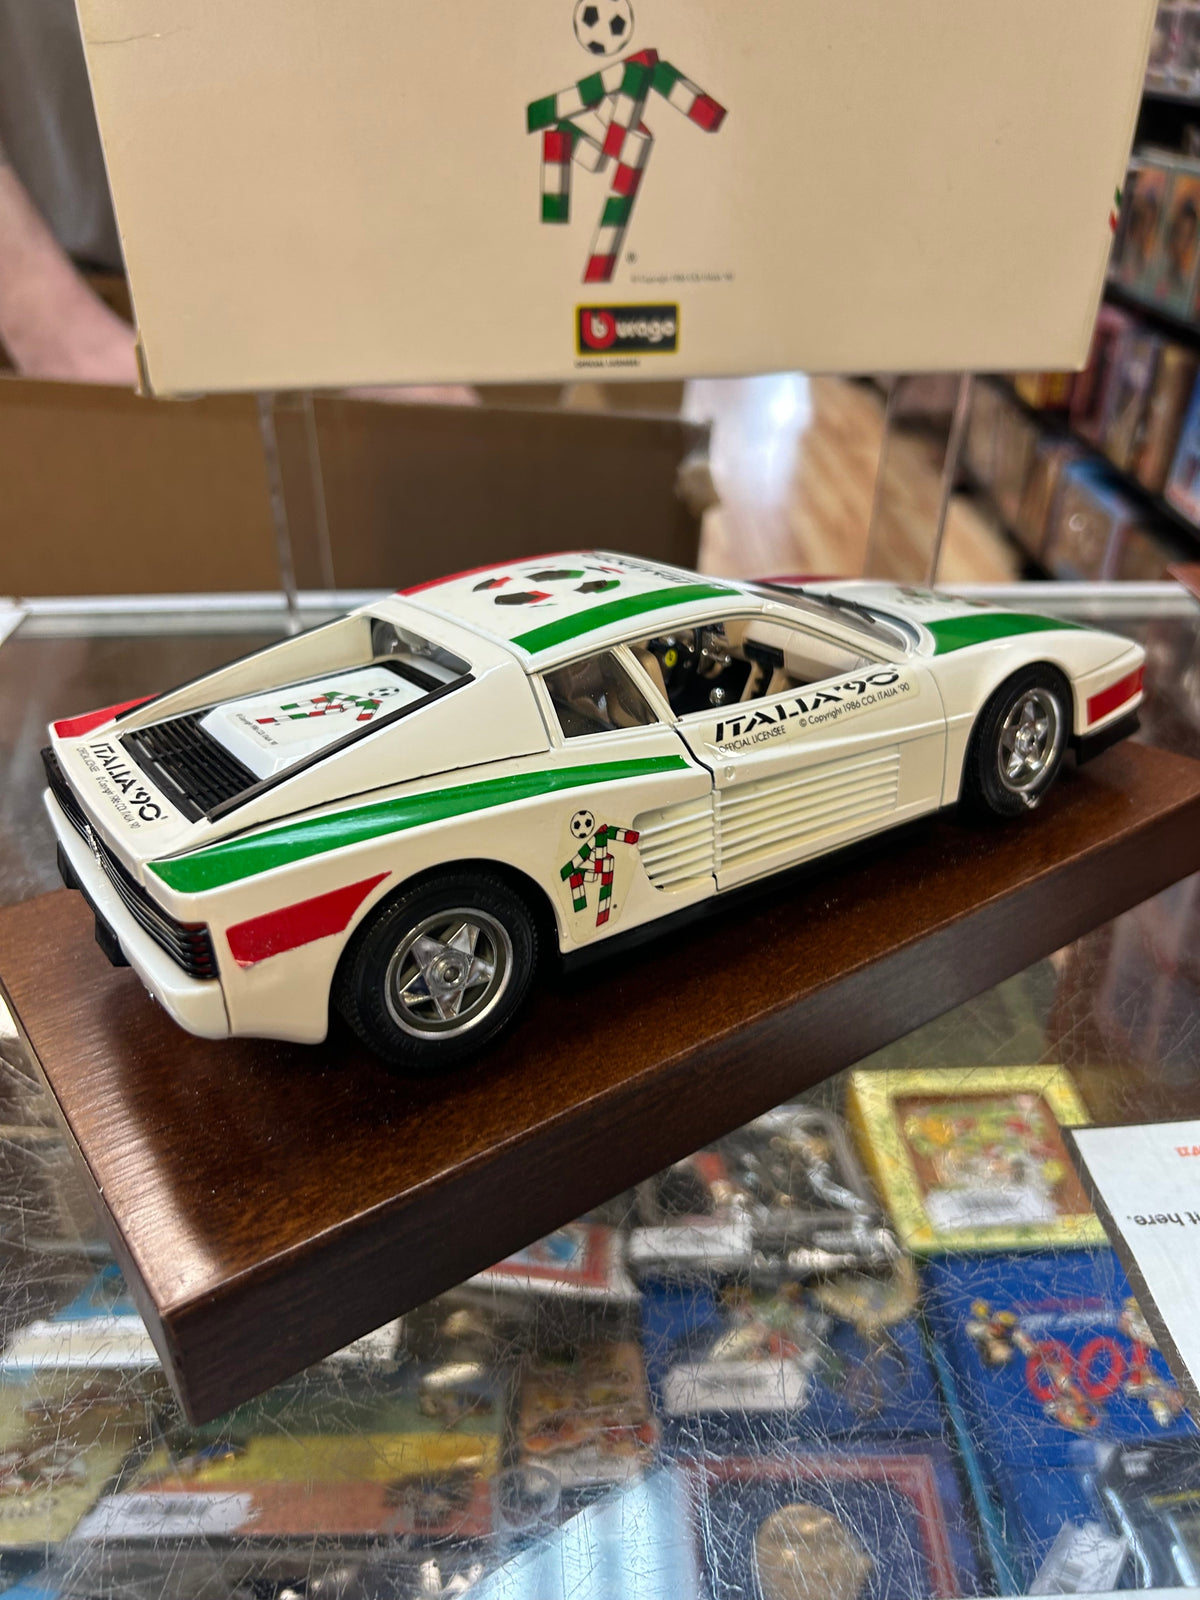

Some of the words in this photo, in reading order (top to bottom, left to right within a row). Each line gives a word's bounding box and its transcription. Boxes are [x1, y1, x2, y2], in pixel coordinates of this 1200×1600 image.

[751, 725, 786, 744] LICENSEE
[808, 707, 843, 726] Copyright
[843, 701, 861, 714] 1986
[861, 695, 877, 706] COL
[877, 688, 898, 702] ITALIA
[1127, 1214, 1185, 1226] here.
